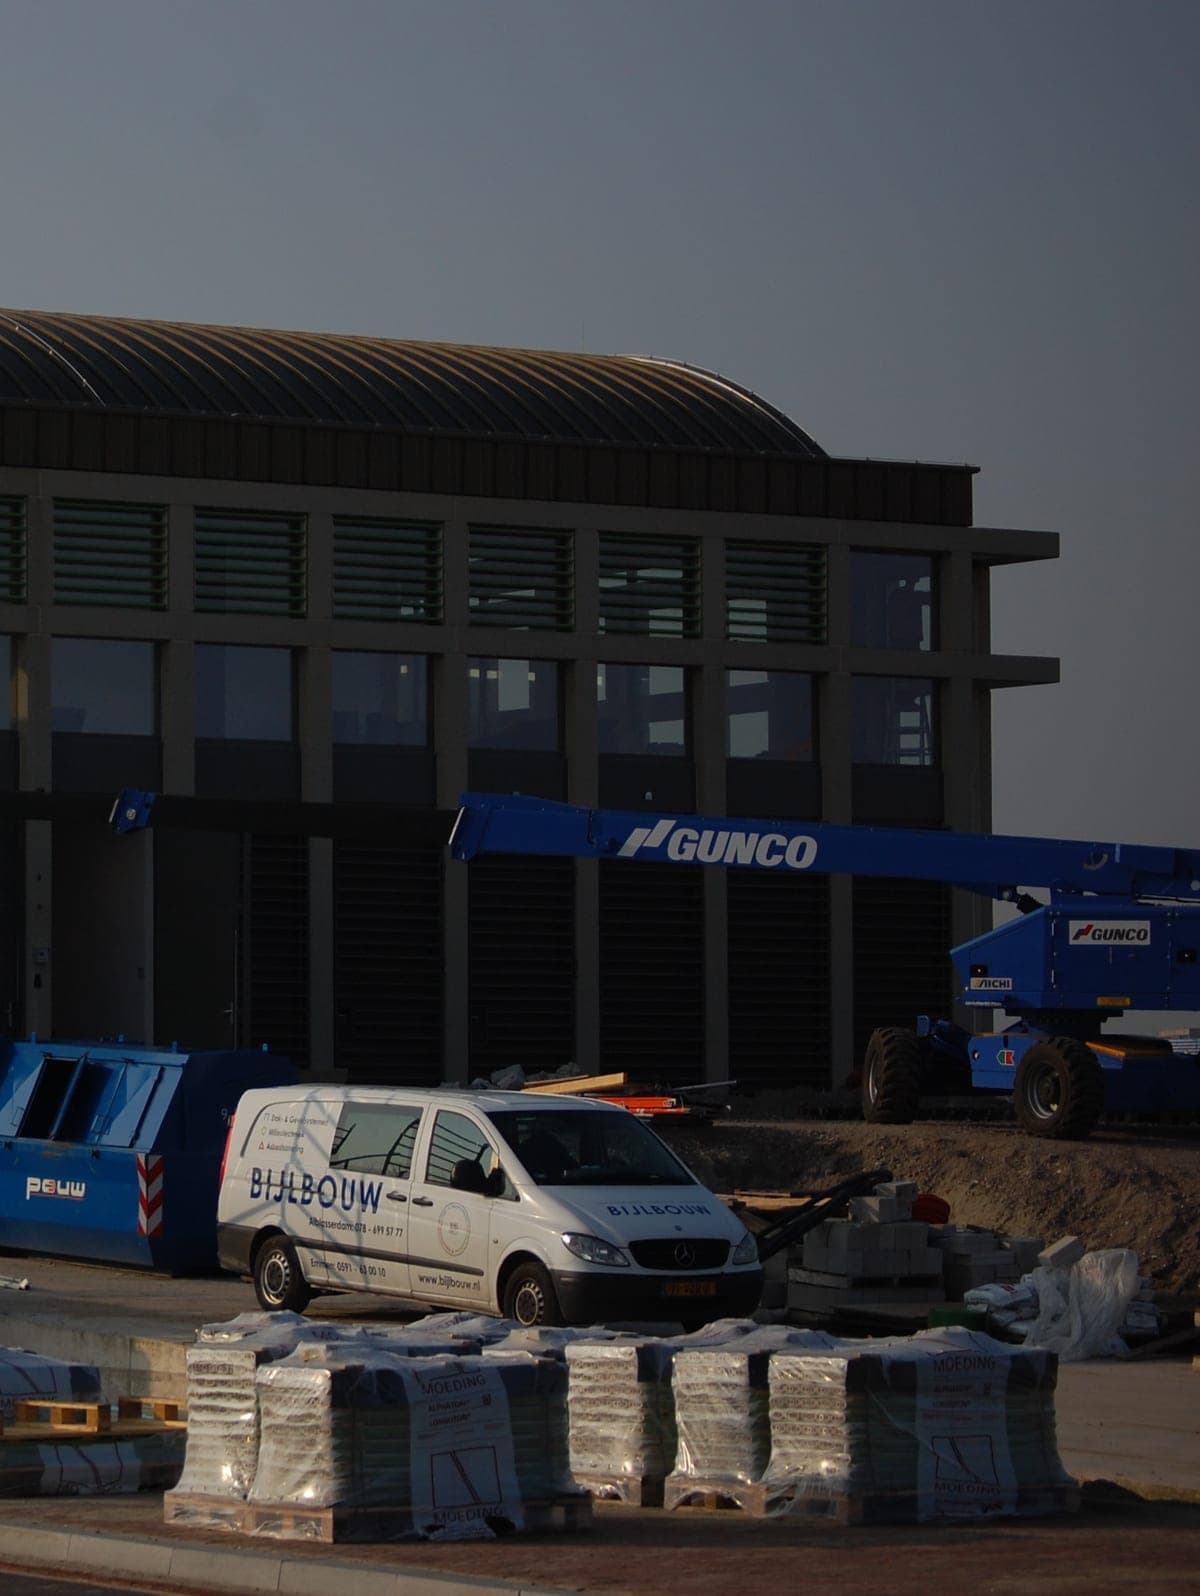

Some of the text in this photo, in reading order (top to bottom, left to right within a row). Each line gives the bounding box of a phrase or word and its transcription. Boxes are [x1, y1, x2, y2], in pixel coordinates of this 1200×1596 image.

[667, 828, 818, 869] GUNCO
[1091, 927, 1149, 941] GUNCO
[250, 1167, 382, 1214] BIJLBOUW
[607, 1205, 712, 1216] BIJLBOUW
[933, 1355, 997, 1373] MOEDING
[422, 1374, 486, 1394] MOEDING
